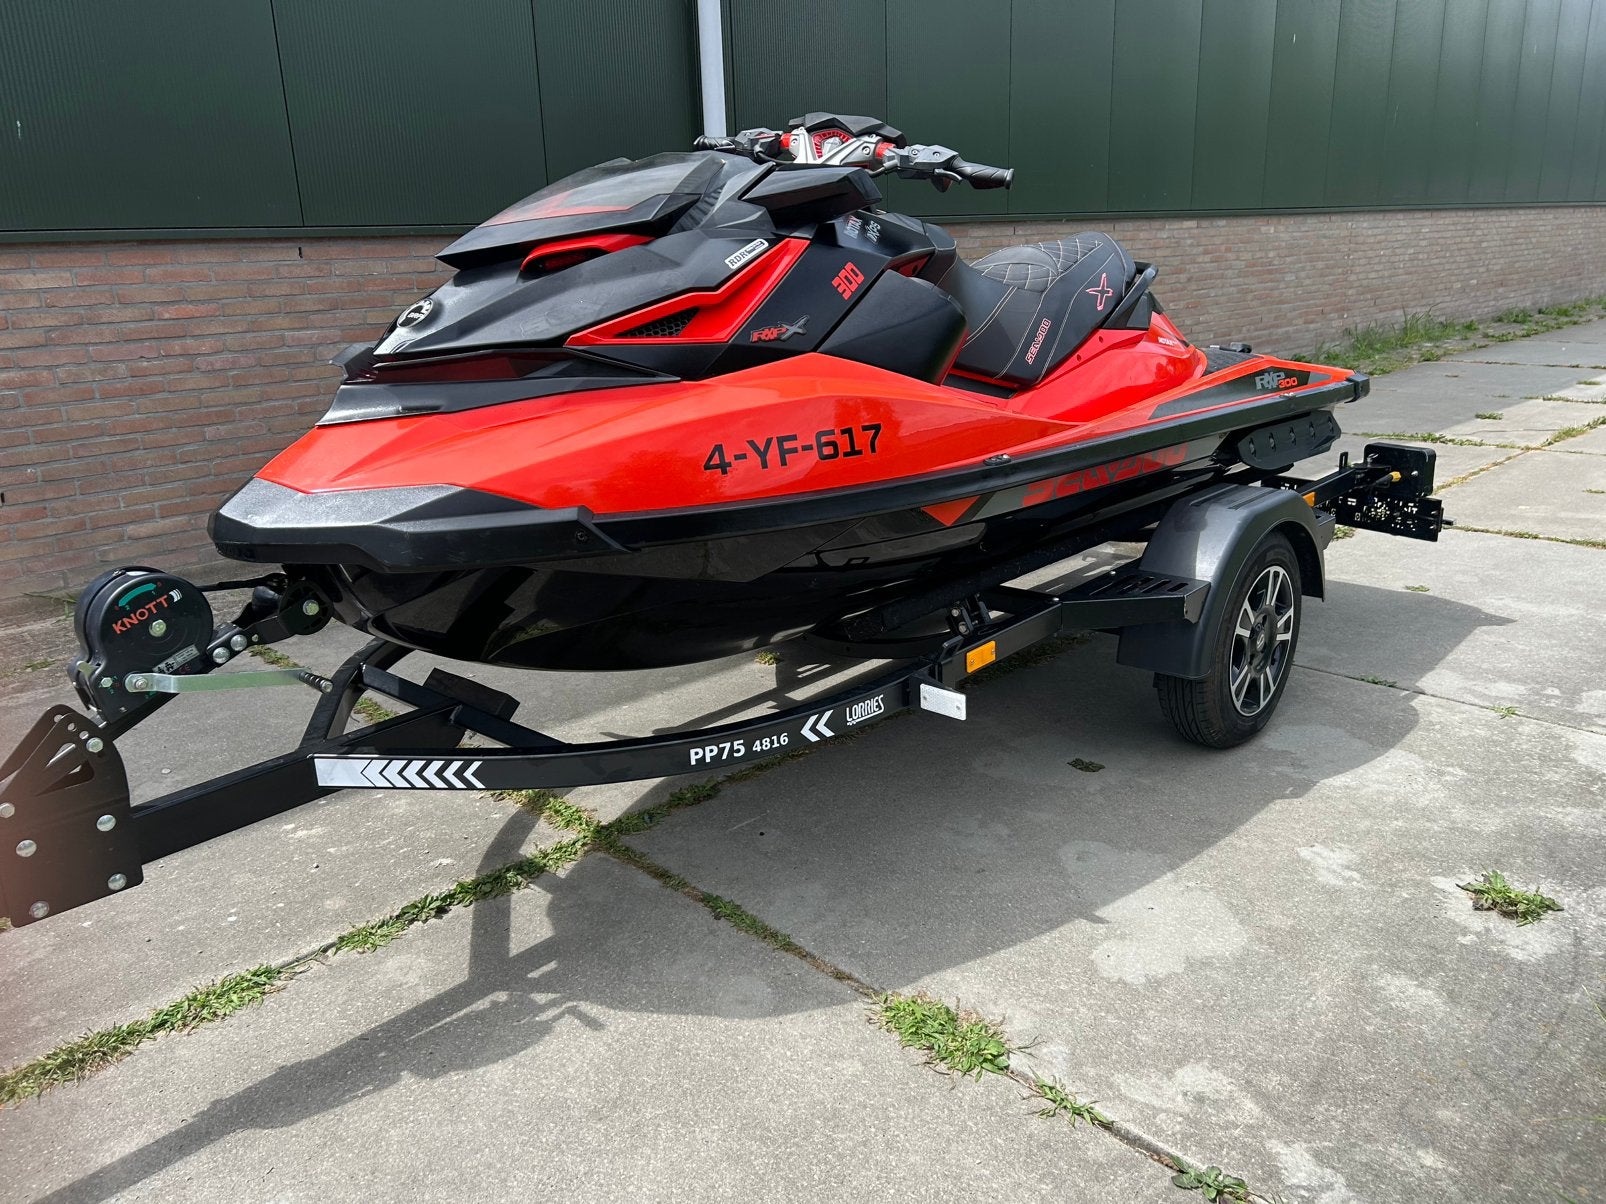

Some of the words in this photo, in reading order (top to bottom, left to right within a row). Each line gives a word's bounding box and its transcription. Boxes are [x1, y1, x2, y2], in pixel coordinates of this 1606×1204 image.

[831, 261, 865, 300] 300
[1279, 376, 1298, 388] 300
[703, 423, 882, 476] 4-YF-617
[112, 594, 169, 634] KNOTT
[846, 694, 884, 725] LORRIES
[689, 739, 746, 766] PP75
[752, 732, 789, 752] 4816
